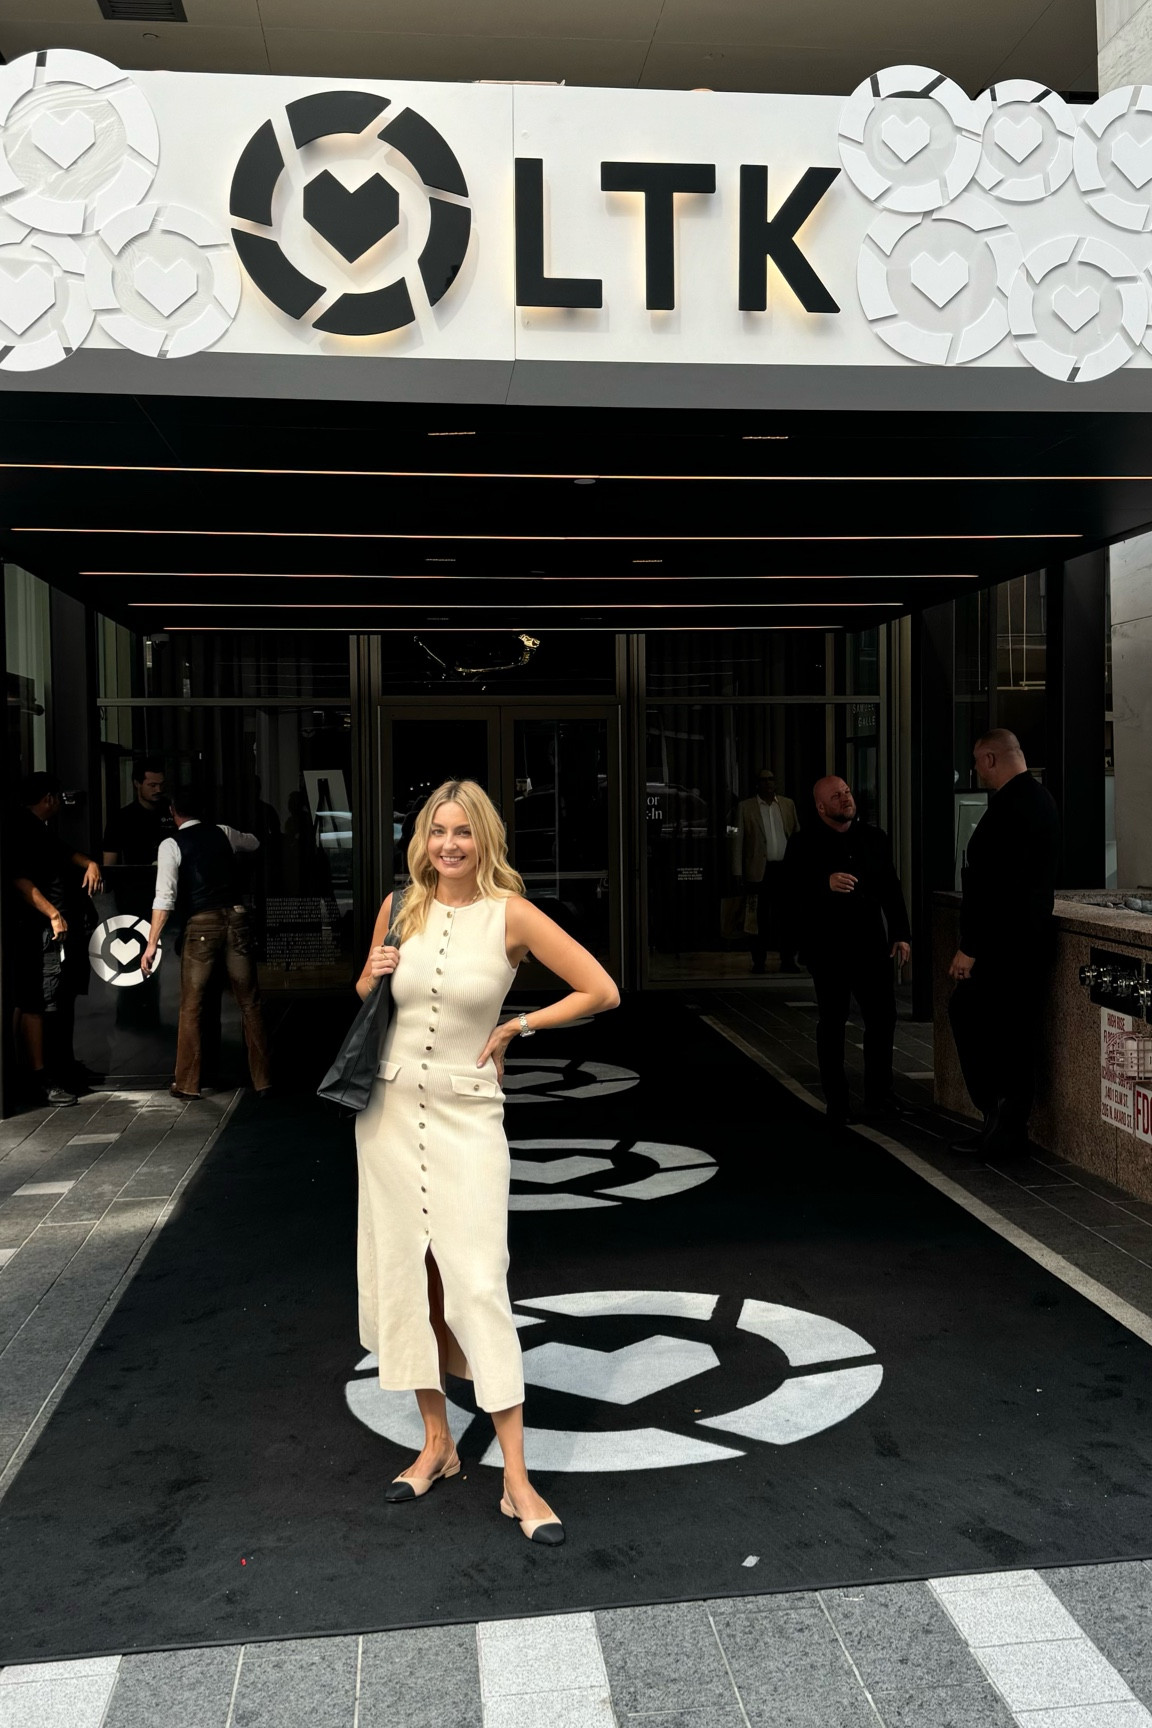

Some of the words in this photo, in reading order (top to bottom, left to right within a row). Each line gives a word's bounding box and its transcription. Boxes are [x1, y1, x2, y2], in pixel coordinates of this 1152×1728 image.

[515, 158, 842, 314] LTK
[1115, 1089, 1123, 1106] ELM
[1114, 1107, 1126, 1126] AKARD
